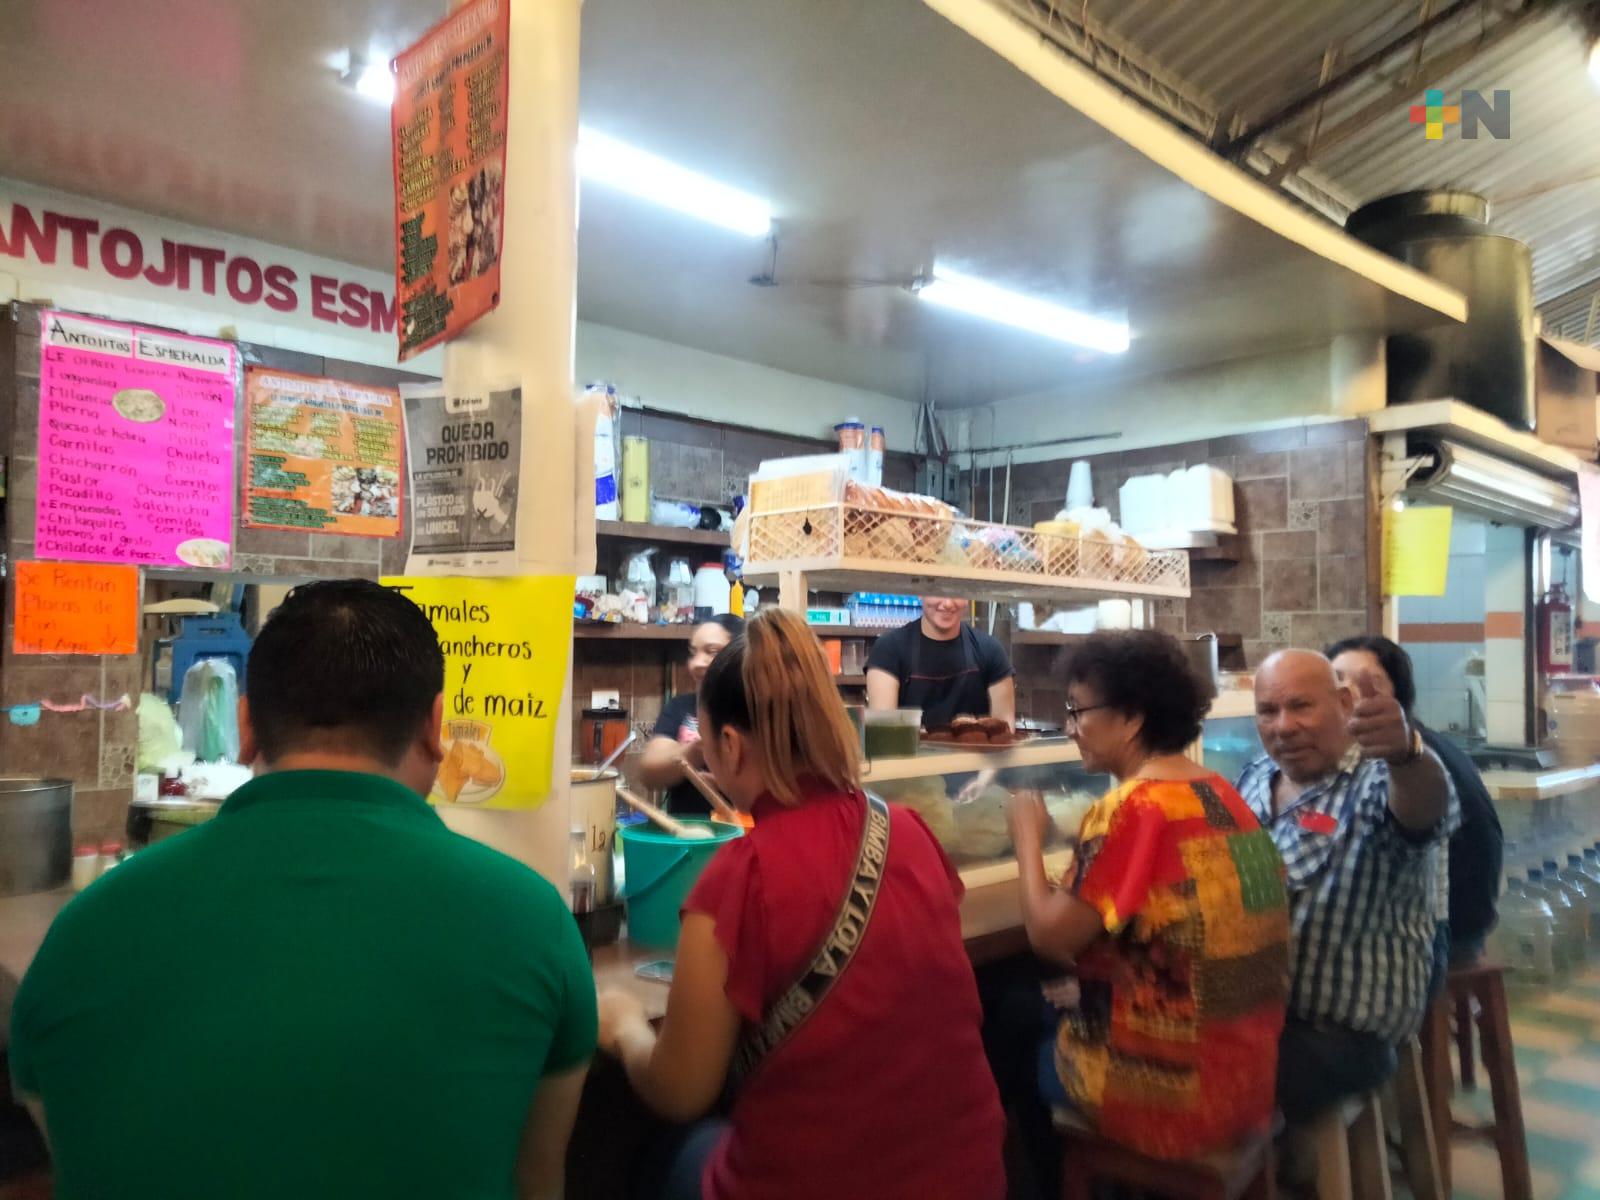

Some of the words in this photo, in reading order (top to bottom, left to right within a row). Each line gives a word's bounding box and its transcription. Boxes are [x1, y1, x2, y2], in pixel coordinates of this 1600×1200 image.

[310, 274, 397, 333] ESM
[139, 338, 227, 367] ESMERALDA
[442, 421, 495, 444] QUEDA
[166, 445, 220, 465] Chuleta
[426, 440, 509, 465] PROHIBIDO
[440, 634, 532, 660] ancheros
[462, 663, 472, 684] y
[453, 687, 474, 715] de
[484, 692, 547, 719] maiz
[858, 809, 888, 880] BIMBA
[853, 880, 875, 908] Y
[813, 898, 866, 978] LOLA
